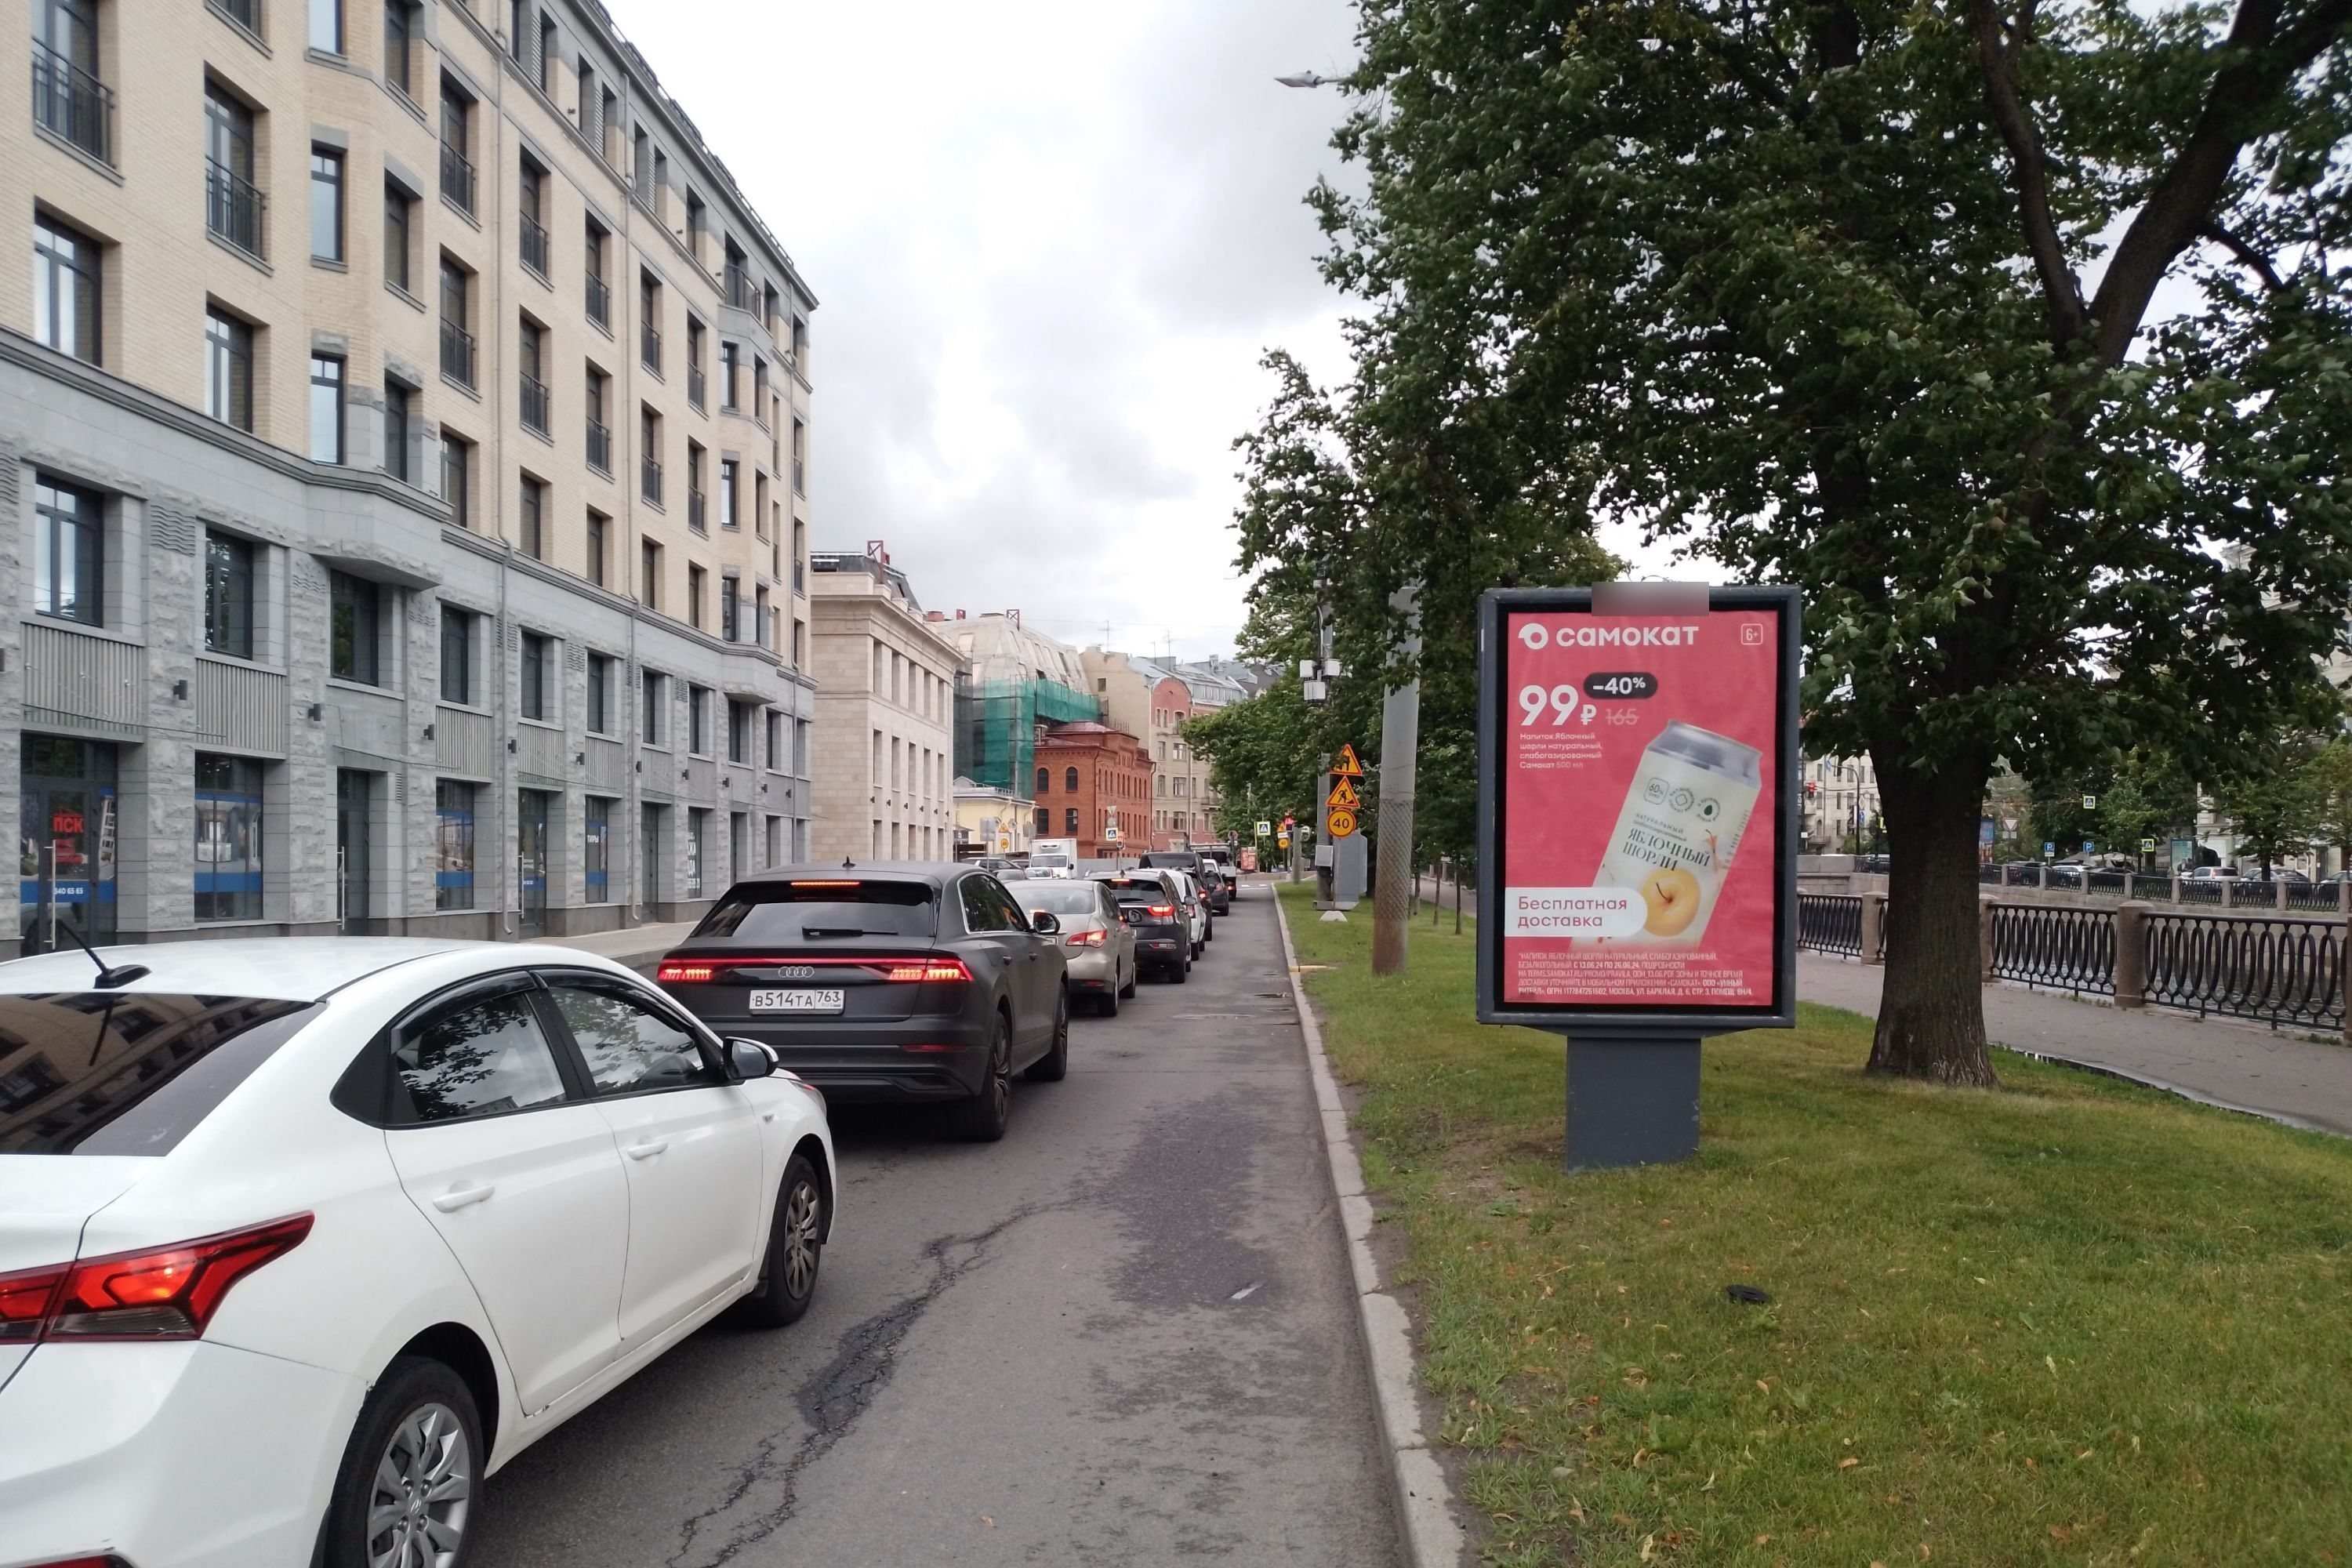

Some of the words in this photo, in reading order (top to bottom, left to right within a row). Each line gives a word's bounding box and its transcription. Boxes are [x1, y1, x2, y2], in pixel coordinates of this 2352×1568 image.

[1556, 625, 1700, 647] самокат
[1745, 630, 1759, 641] 6+
[1605, 708, 1639, 726] 165
[1548, 742, 1603, 750] натуральный,
[1519, 751, 1602, 760] слабогазированный
[53, 817, 83, 833] ПСК
[1333, 818, 1350, 829] 40
[1628, 827, 1711, 867] ЯБЛОЧНЫЙ
[1622, 841, 1679, 871] ШОРЛИ
[1518, 895, 1628, 910] Бесплатная
[1517, 916, 1603, 929] доставка
[817, 991, 840, 1003] 763
